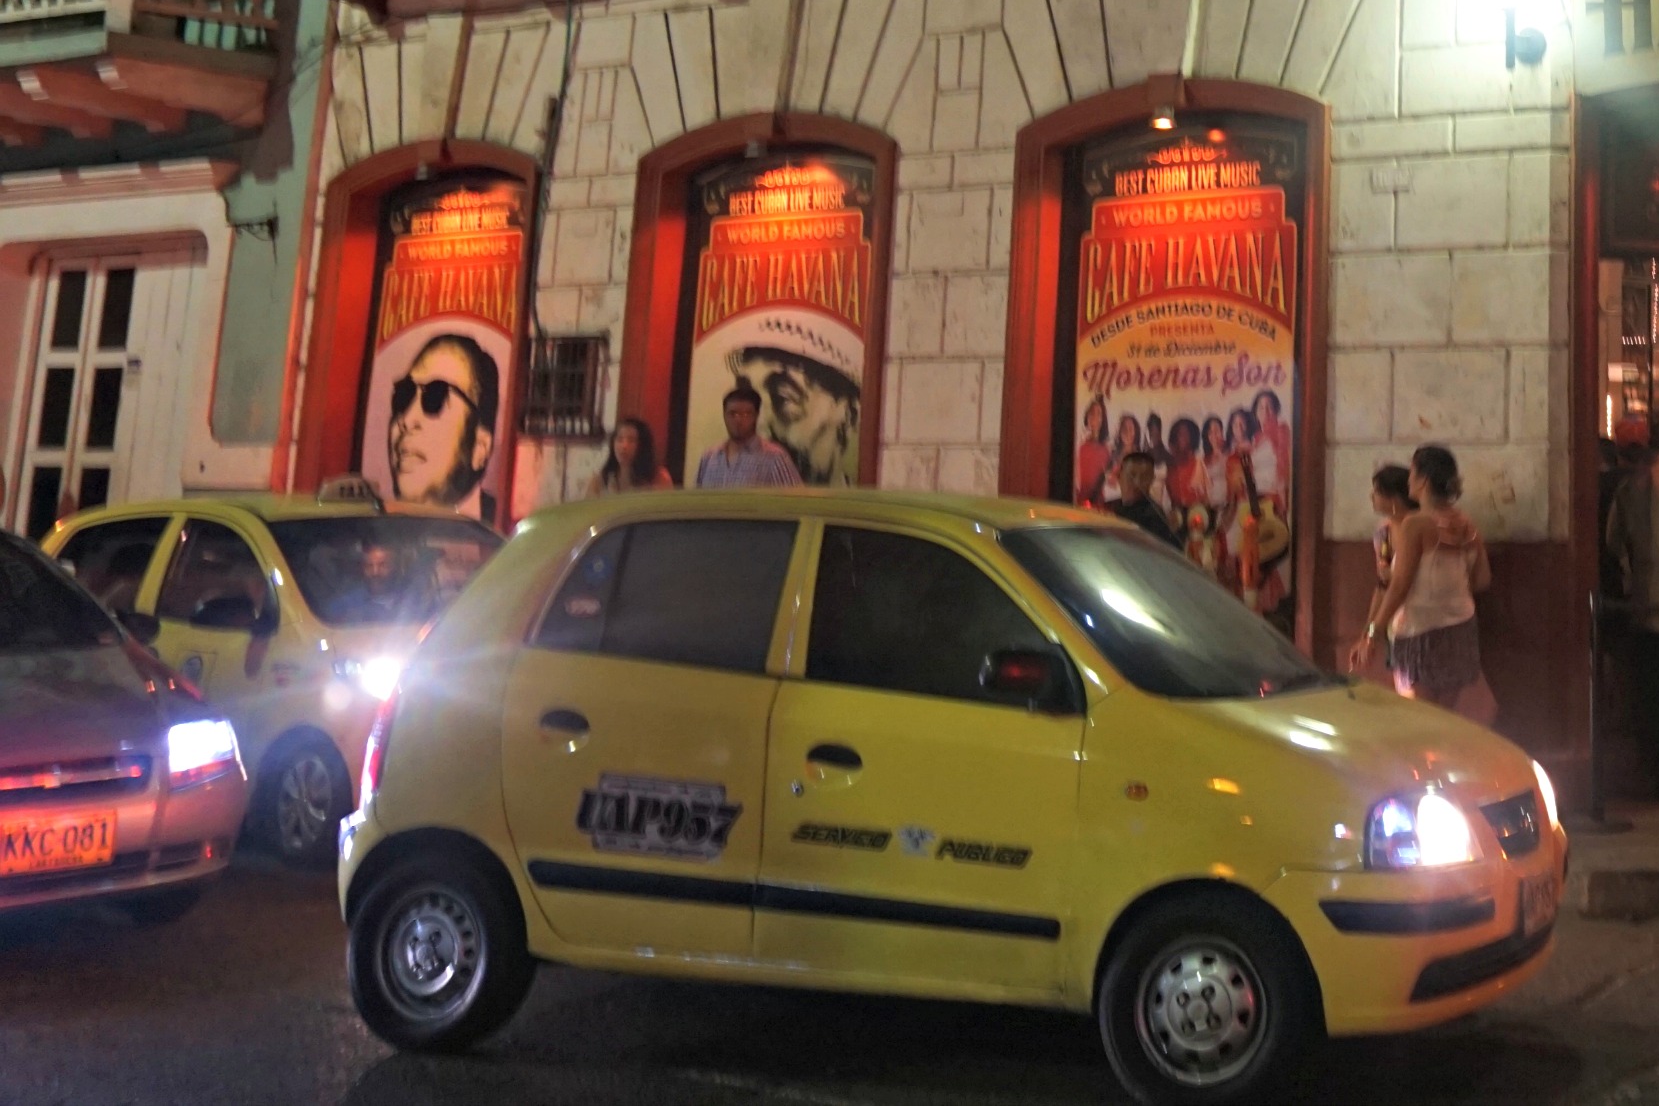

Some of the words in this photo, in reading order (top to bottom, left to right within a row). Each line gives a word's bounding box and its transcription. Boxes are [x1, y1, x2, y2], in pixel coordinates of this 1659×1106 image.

[1115, 170, 1144, 196] BEST
[1147, 165, 1188, 193] CUBAN
[1191, 163, 1218, 190] LIVE
[1220, 160, 1261, 187] MUSIC
[729, 191, 753, 216] BEST
[754, 189, 788, 214] CUBAN
[790, 186, 812, 212] LIVE
[813, 184, 845, 210] MUSIC
[1112, 203, 1178, 228] WORLD
[1184, 198, 1263, 222] FAMOUS
[455, 238, 507, 258] FAMOUS
[727, 222, 779, 244] WORLD
[783, 219, 845, 240] FAMOUS
[702, 254, 760, 331] CAFE
[767, 250, 861, 327] HAVANA
[1086, 238, 1155, 324] CAFE
[1165, 230, 1287, 315] HAVANA
[439, 264, 517, 335] HAVANA
[1091, 316, 1133, 348] DESDE
[1137, 302, 1213, 324] SANTIAGO
[1215, 306, 1235, 323] DE
[1238, 311, 1278, 342] CUBA
[1149, 320, 1215, 338] PRESENTA
[792, 822, 892, 851] SERVICIO
[935, 841, 1033, 869] PUBLICO
